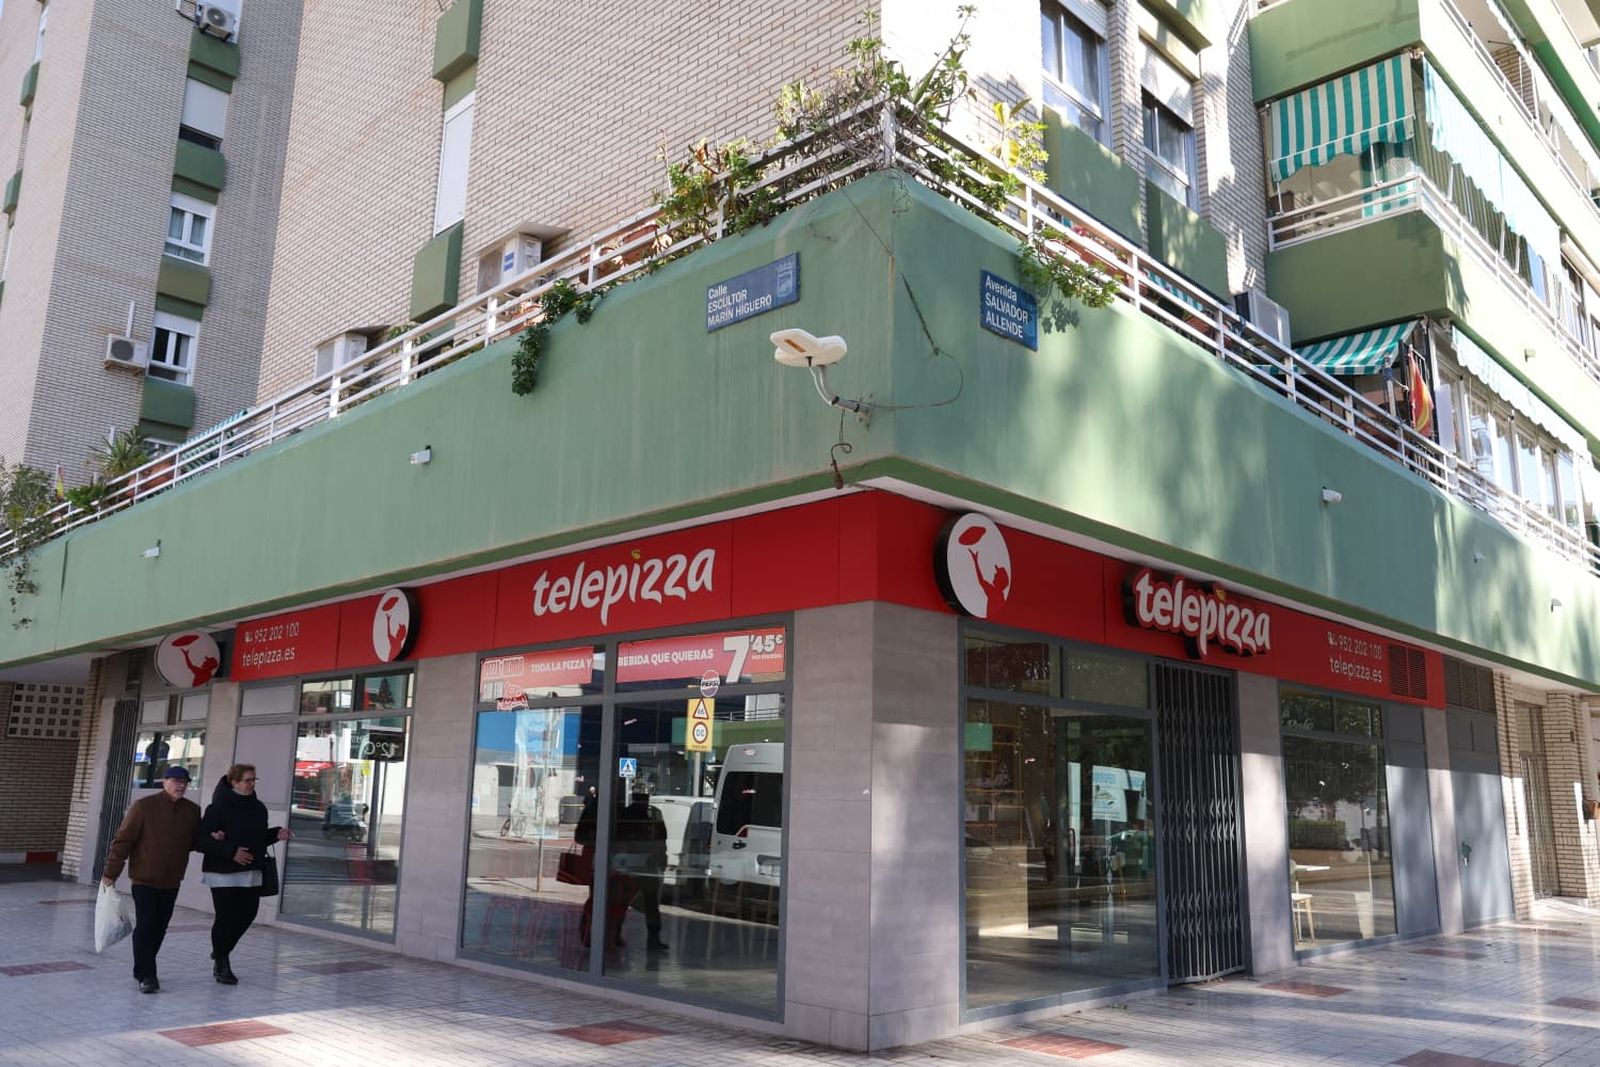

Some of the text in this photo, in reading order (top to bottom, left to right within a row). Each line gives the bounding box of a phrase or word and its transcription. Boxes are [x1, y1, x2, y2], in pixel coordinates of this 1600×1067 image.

[708, 284, 728, 300] Calle
[708, 289, 748, 313] ESCULTOR
[985, 274, 1017, 302] Avenida
[708, 294, 772, 329] MARÍN HIGUERO
[985, 292, 1029, 325] SALVADOR
[986, 311, 1024, 339] ALLENDE
[532, 548, 716, 627] telepizza
[1135, 572, 1271, 656] telepizza
[254, 621, 300, 643] 952 202 100
[242, 647, 296, 669] telepizza.es
[651, 651, 671, 666] QUE
[671, 648, 715, 662] QUIERAS
[1339, 635, 1383, 660] 952 202 100
[1329, 654, 1383, 684] telepizza.es
